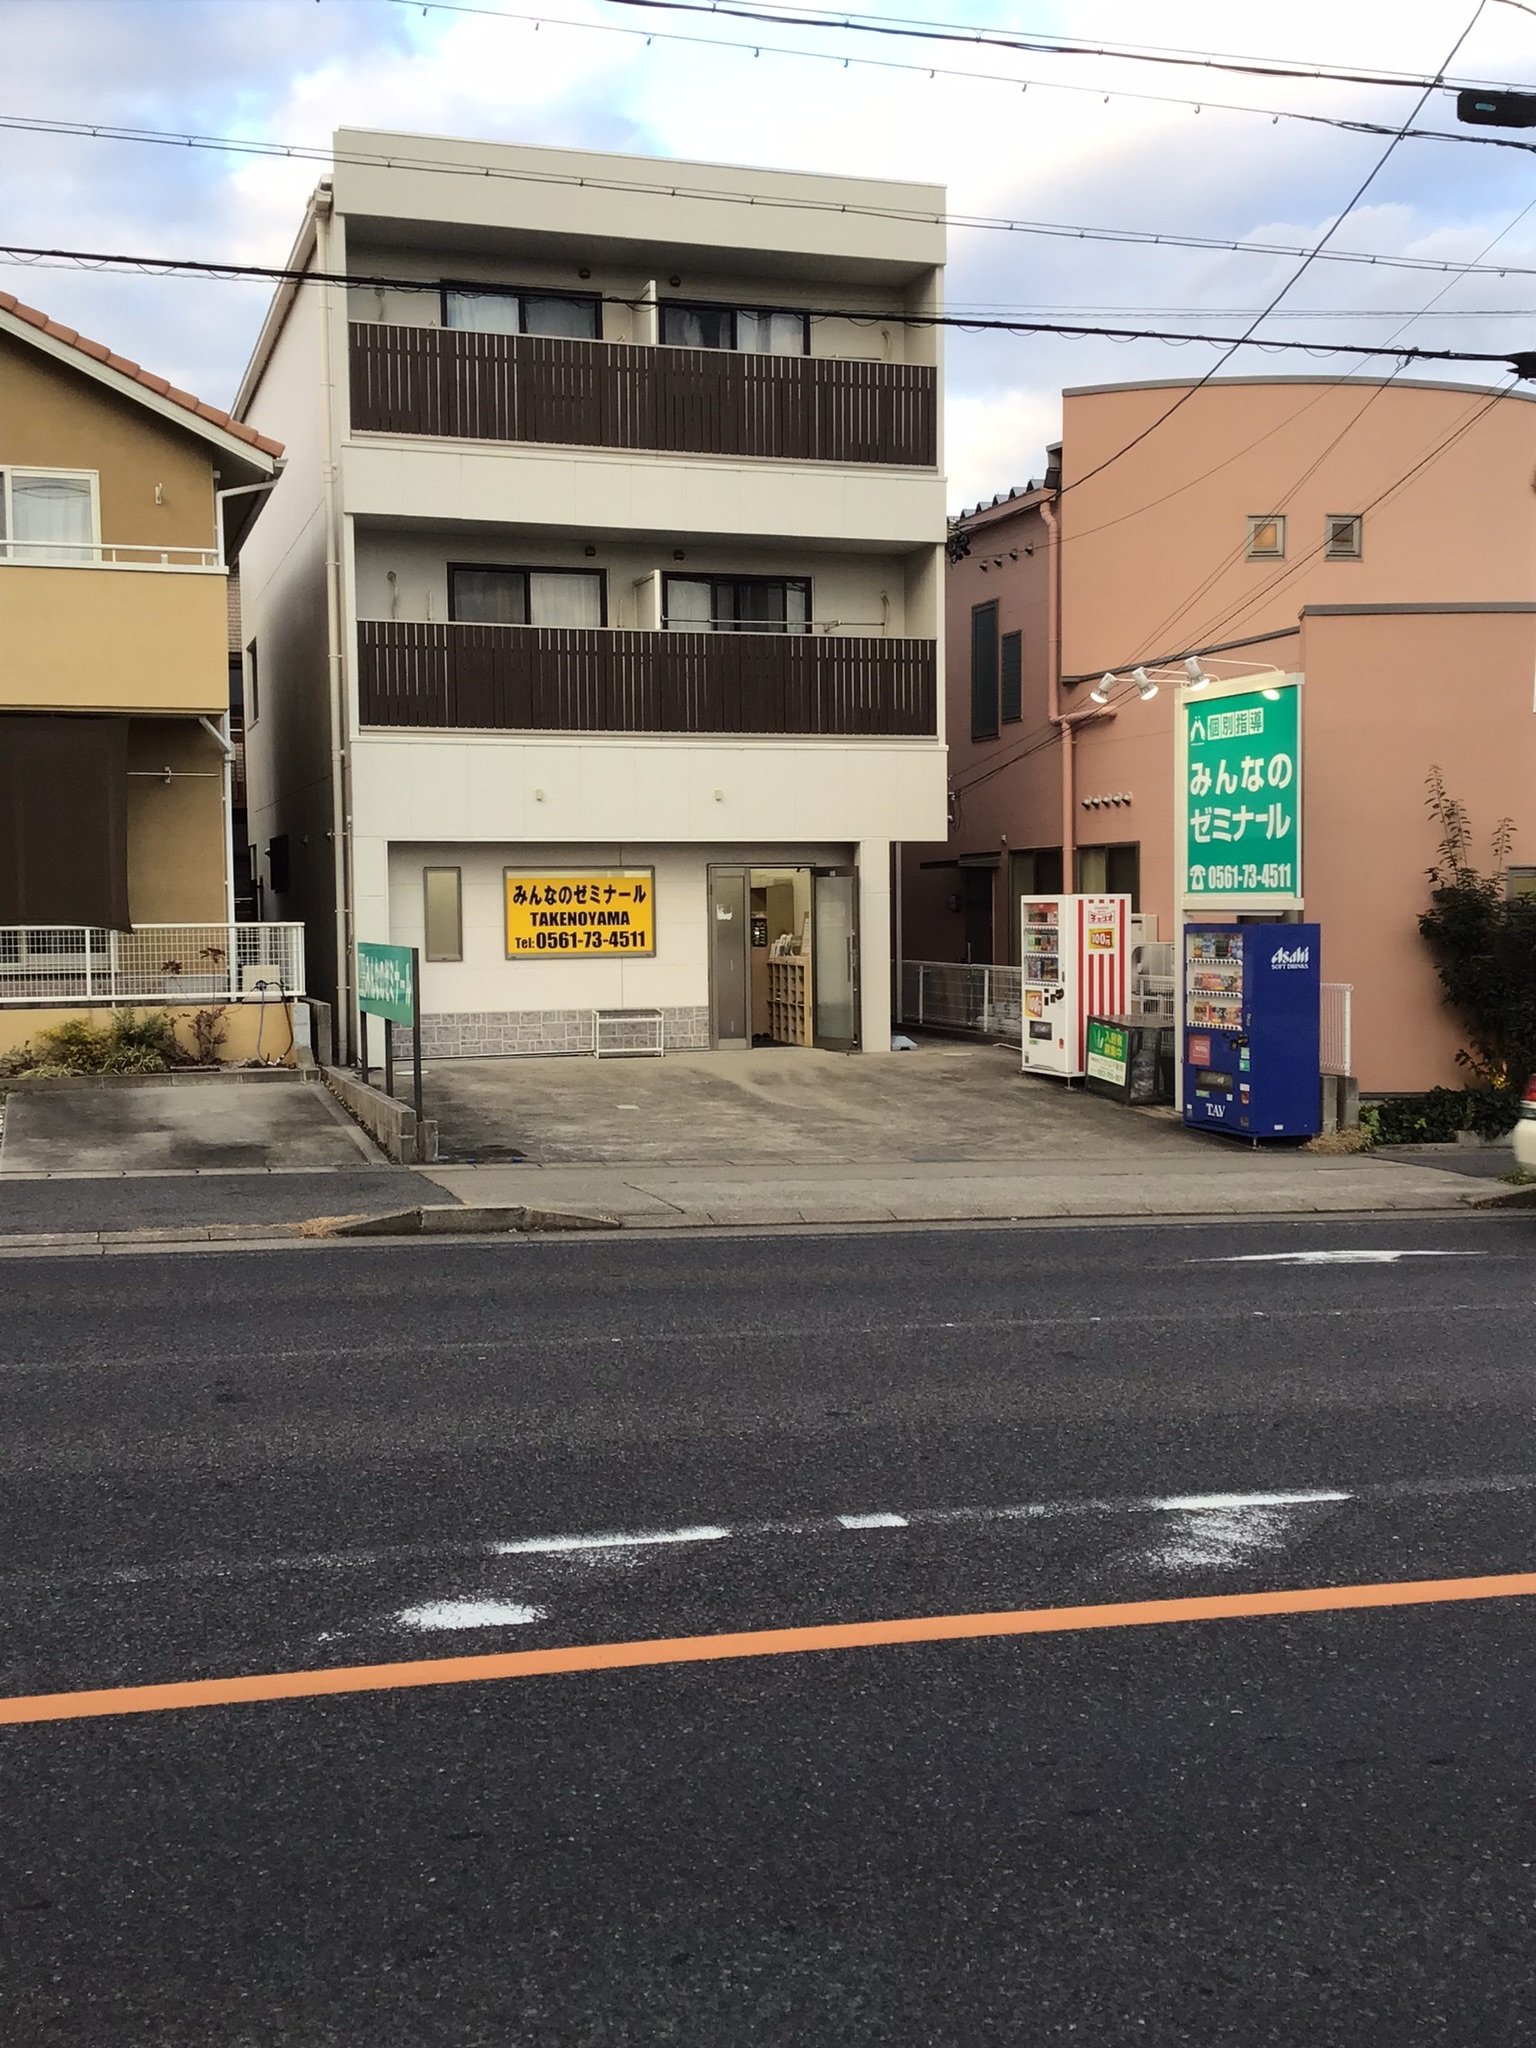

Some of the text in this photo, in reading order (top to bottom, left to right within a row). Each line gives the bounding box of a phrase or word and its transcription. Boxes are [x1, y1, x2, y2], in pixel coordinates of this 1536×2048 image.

[1208, 709, 1263, 739] 個別指導
[1190, 753, 1292, 797] みんなの
[1190, 802, 1291, 844] ゼミナール
[1208, 863, 1292, 890] 0561-73-4511
[512, 884, 647, 906] みんなのゼミナール
[530, 911, 630, 927] TAKENOYAMA
[1271, 946, 1309, 964] Asahi
